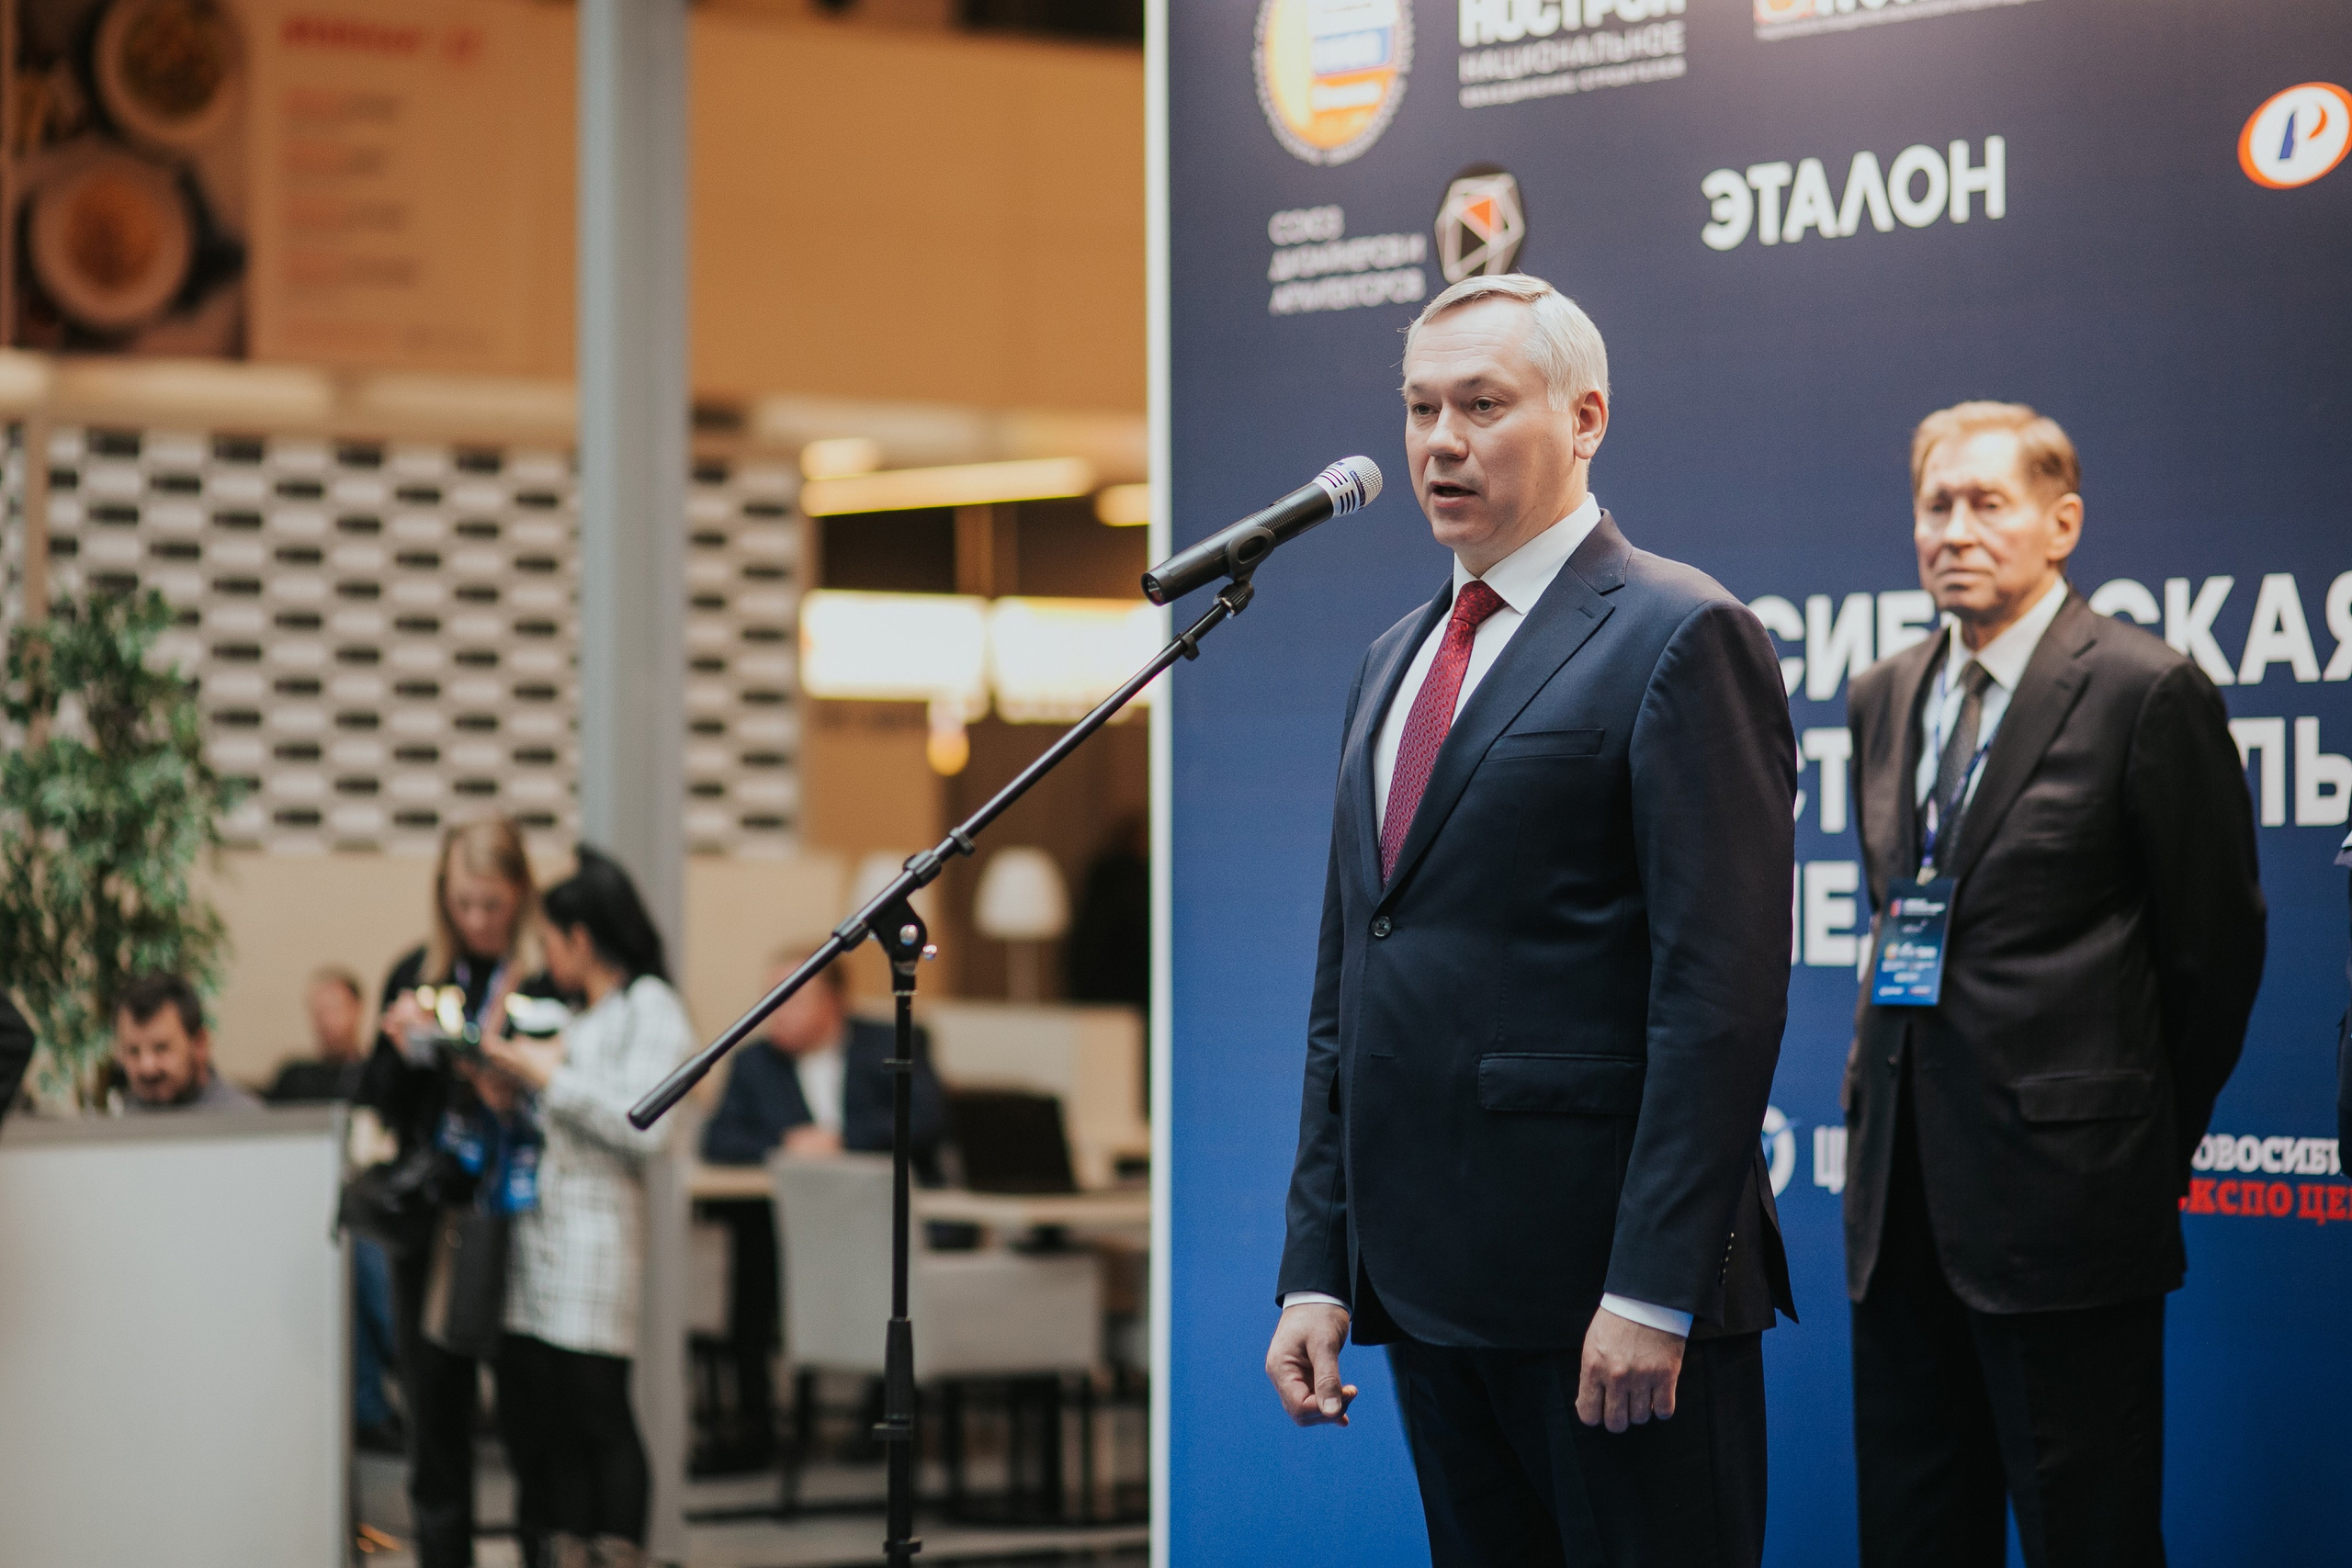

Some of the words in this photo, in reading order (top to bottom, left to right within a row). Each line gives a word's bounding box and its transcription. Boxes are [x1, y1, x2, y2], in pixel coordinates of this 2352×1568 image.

[1702, 135, 2007, 252] ЭТАЛОН
[2190, 1133, 2341, 1176] ОВОСИБ
[2178, 1178, 2294, 1217] КСПО
[2298, 1183, 2352, 1226] ЦЕ
